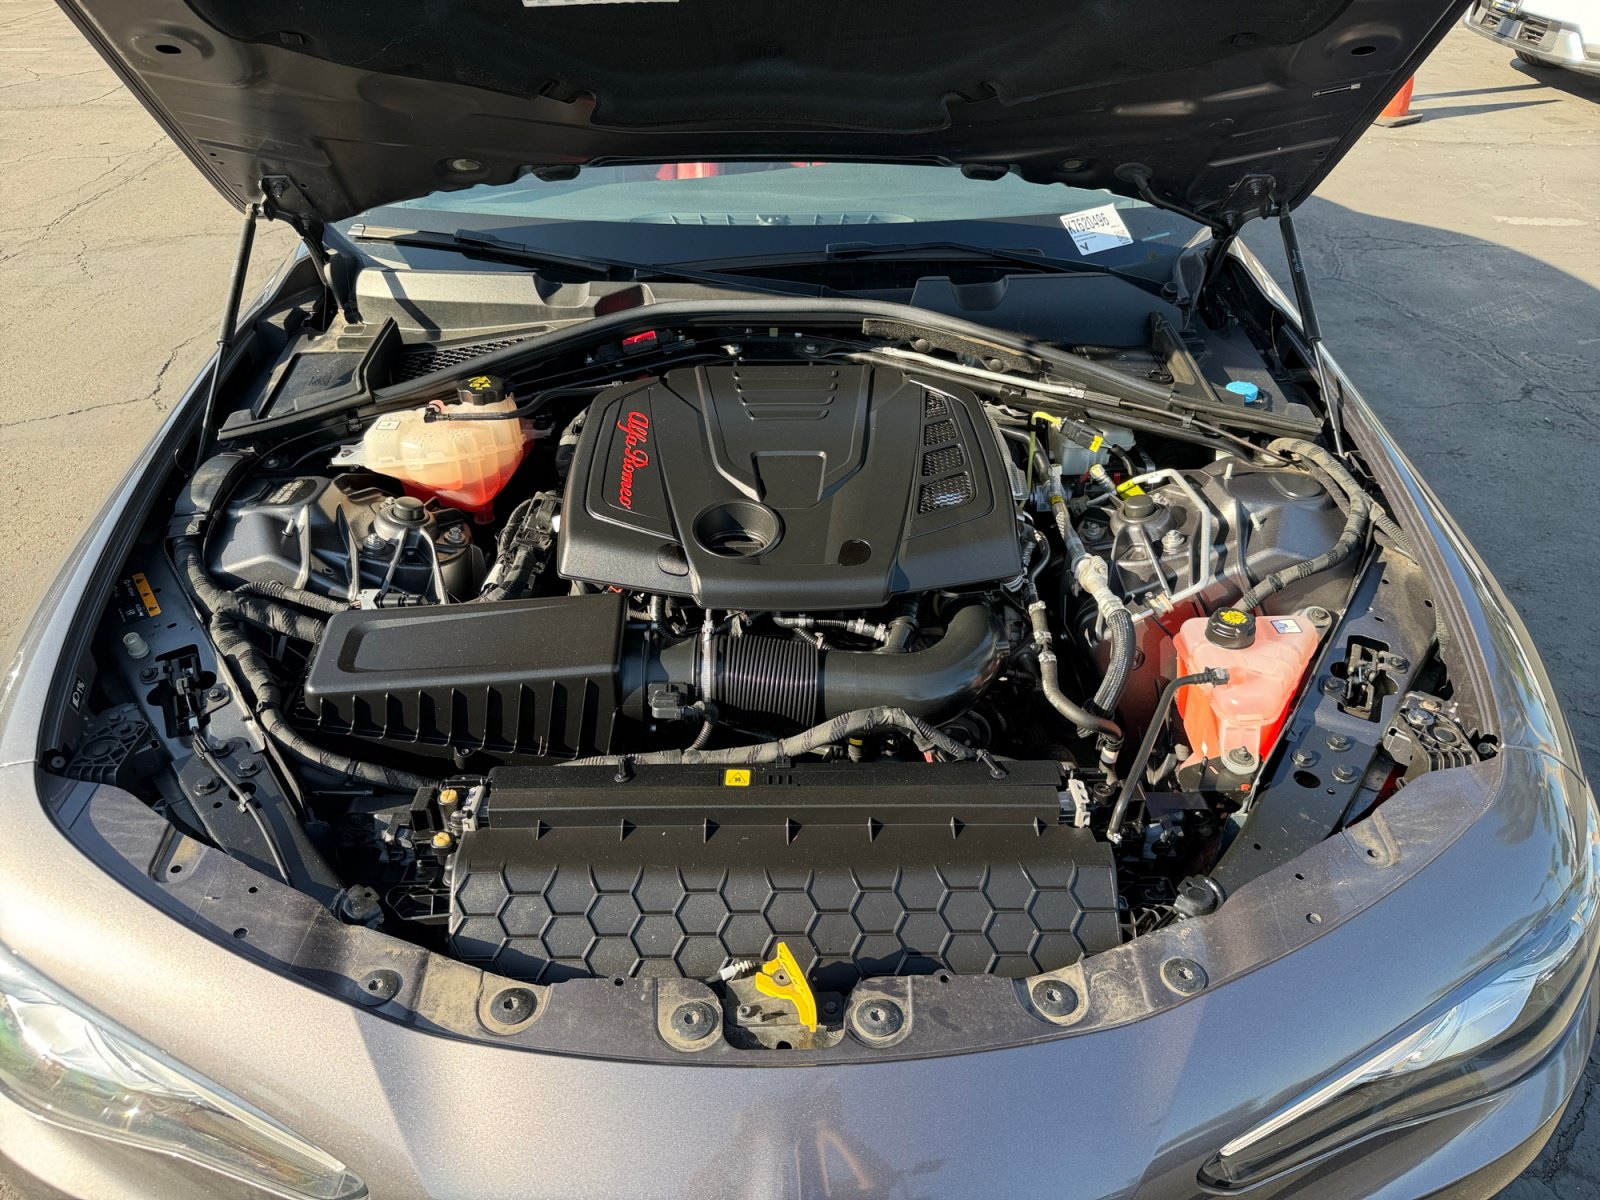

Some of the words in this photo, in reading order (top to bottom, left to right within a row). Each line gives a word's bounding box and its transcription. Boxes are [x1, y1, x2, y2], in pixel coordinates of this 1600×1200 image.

[1064, 212, 1110, 235] K7620496
[617, 411, 649, 449] Alfa
[619, 448, 649, 510] Romeo
